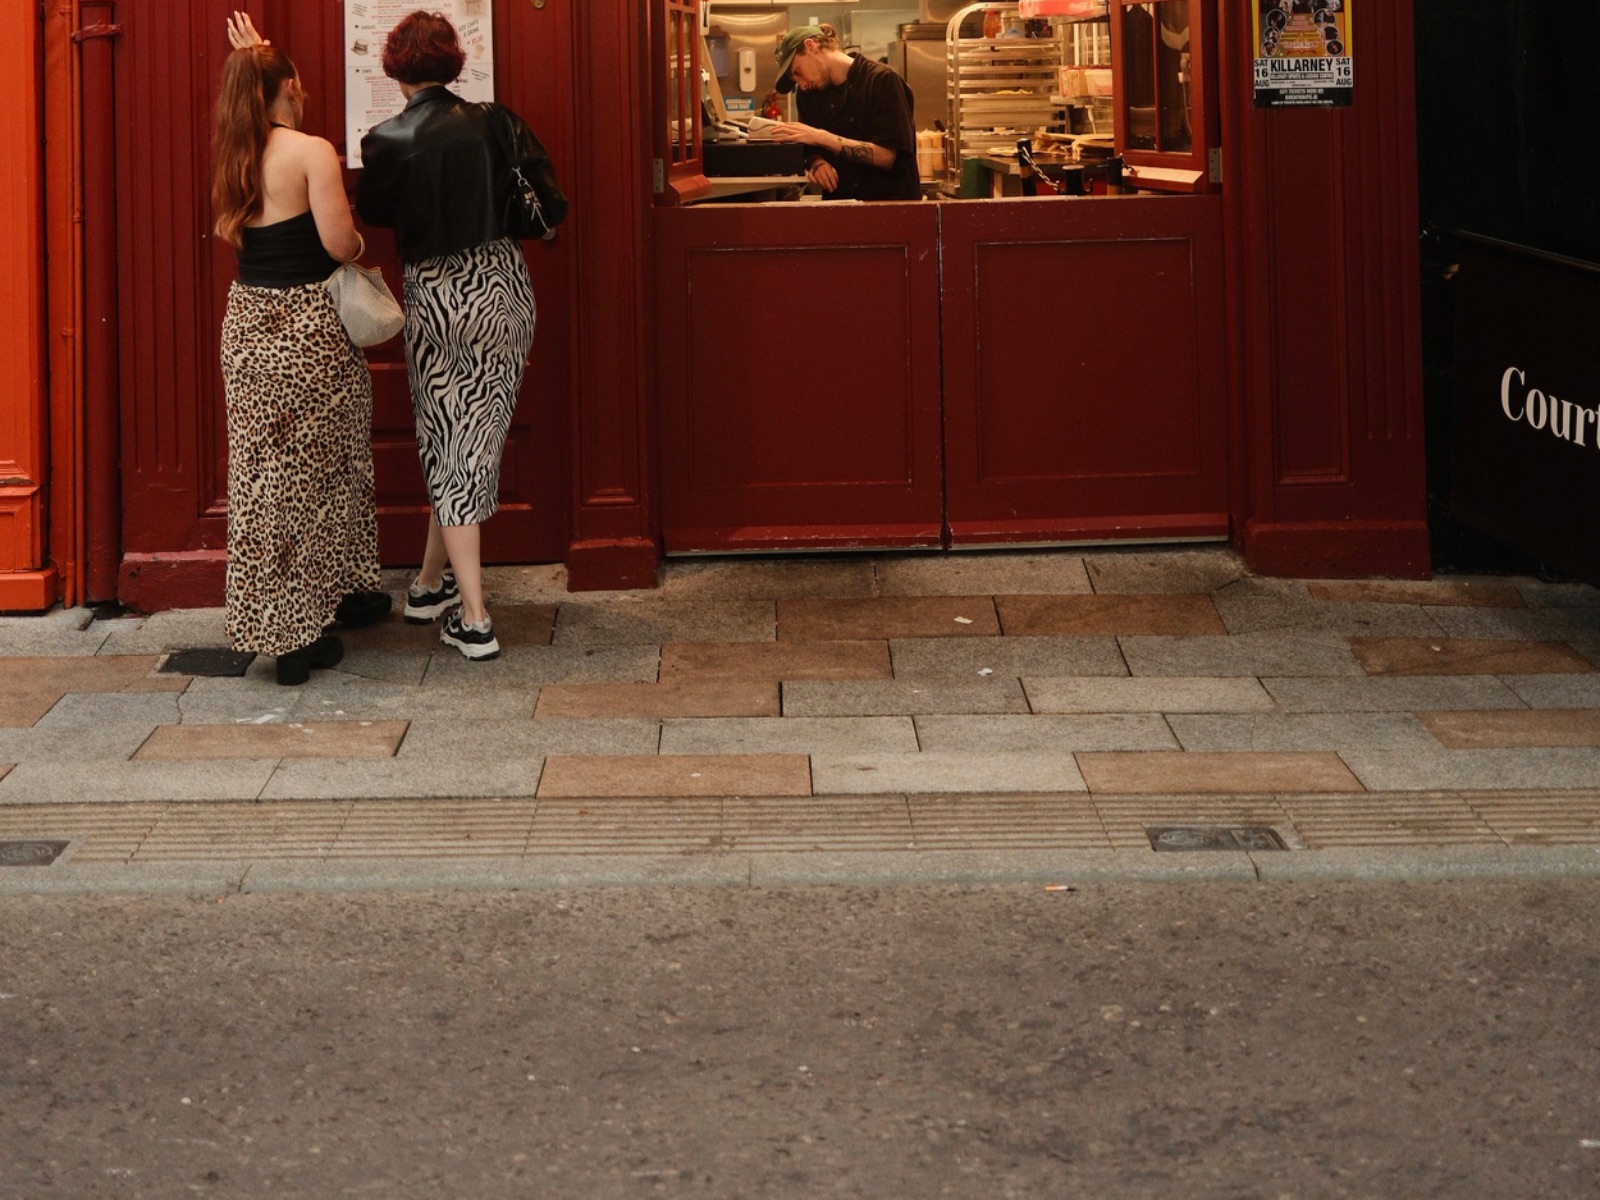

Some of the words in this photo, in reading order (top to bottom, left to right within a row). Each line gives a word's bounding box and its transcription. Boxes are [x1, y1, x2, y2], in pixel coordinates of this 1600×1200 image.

[1254, 59, 1268, 67] SAT
[1270, 59, 1334, 72] KILLARNEY
[1255, 68, 1269, 78] 16
[1336, 67, 1350, 76] 16
[1254, 79, 1270, 87] AUG
[1336, 78, 1352, 86] AUG
